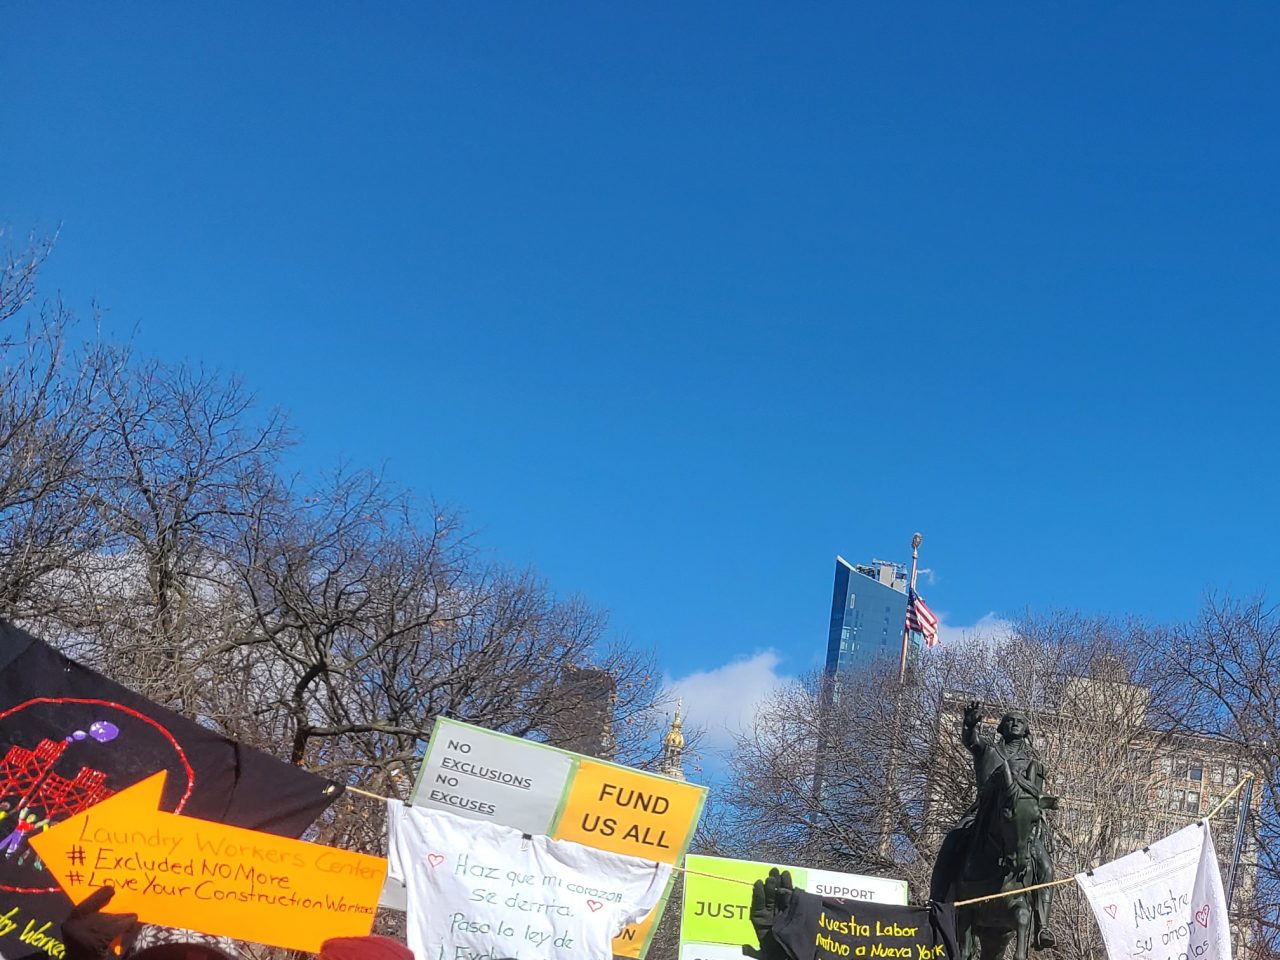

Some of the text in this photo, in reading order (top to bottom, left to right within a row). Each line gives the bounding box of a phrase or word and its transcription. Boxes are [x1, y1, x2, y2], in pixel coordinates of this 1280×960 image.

[448, 739, 471, 753] NO
[436, 774, 458, 787] NO
[440, 757, 532, 790] EXCLUSIONS
[429, 789, 496, 815] EXCUSES
[599, 783, 669, 815] FUND
[581, 813, 669, 848] US ALL
[79, 815, 384, 879] Laundry Workers Center
[455, 853, 500, 879] Haz
[506, 871, 535, 887] que
[815, 885, 875, 900] SUPPORT
[694, 901, 750, 921] JUST
[876, 921, 918, 937] Labor
[870, 943, 912, 958] Nueva
